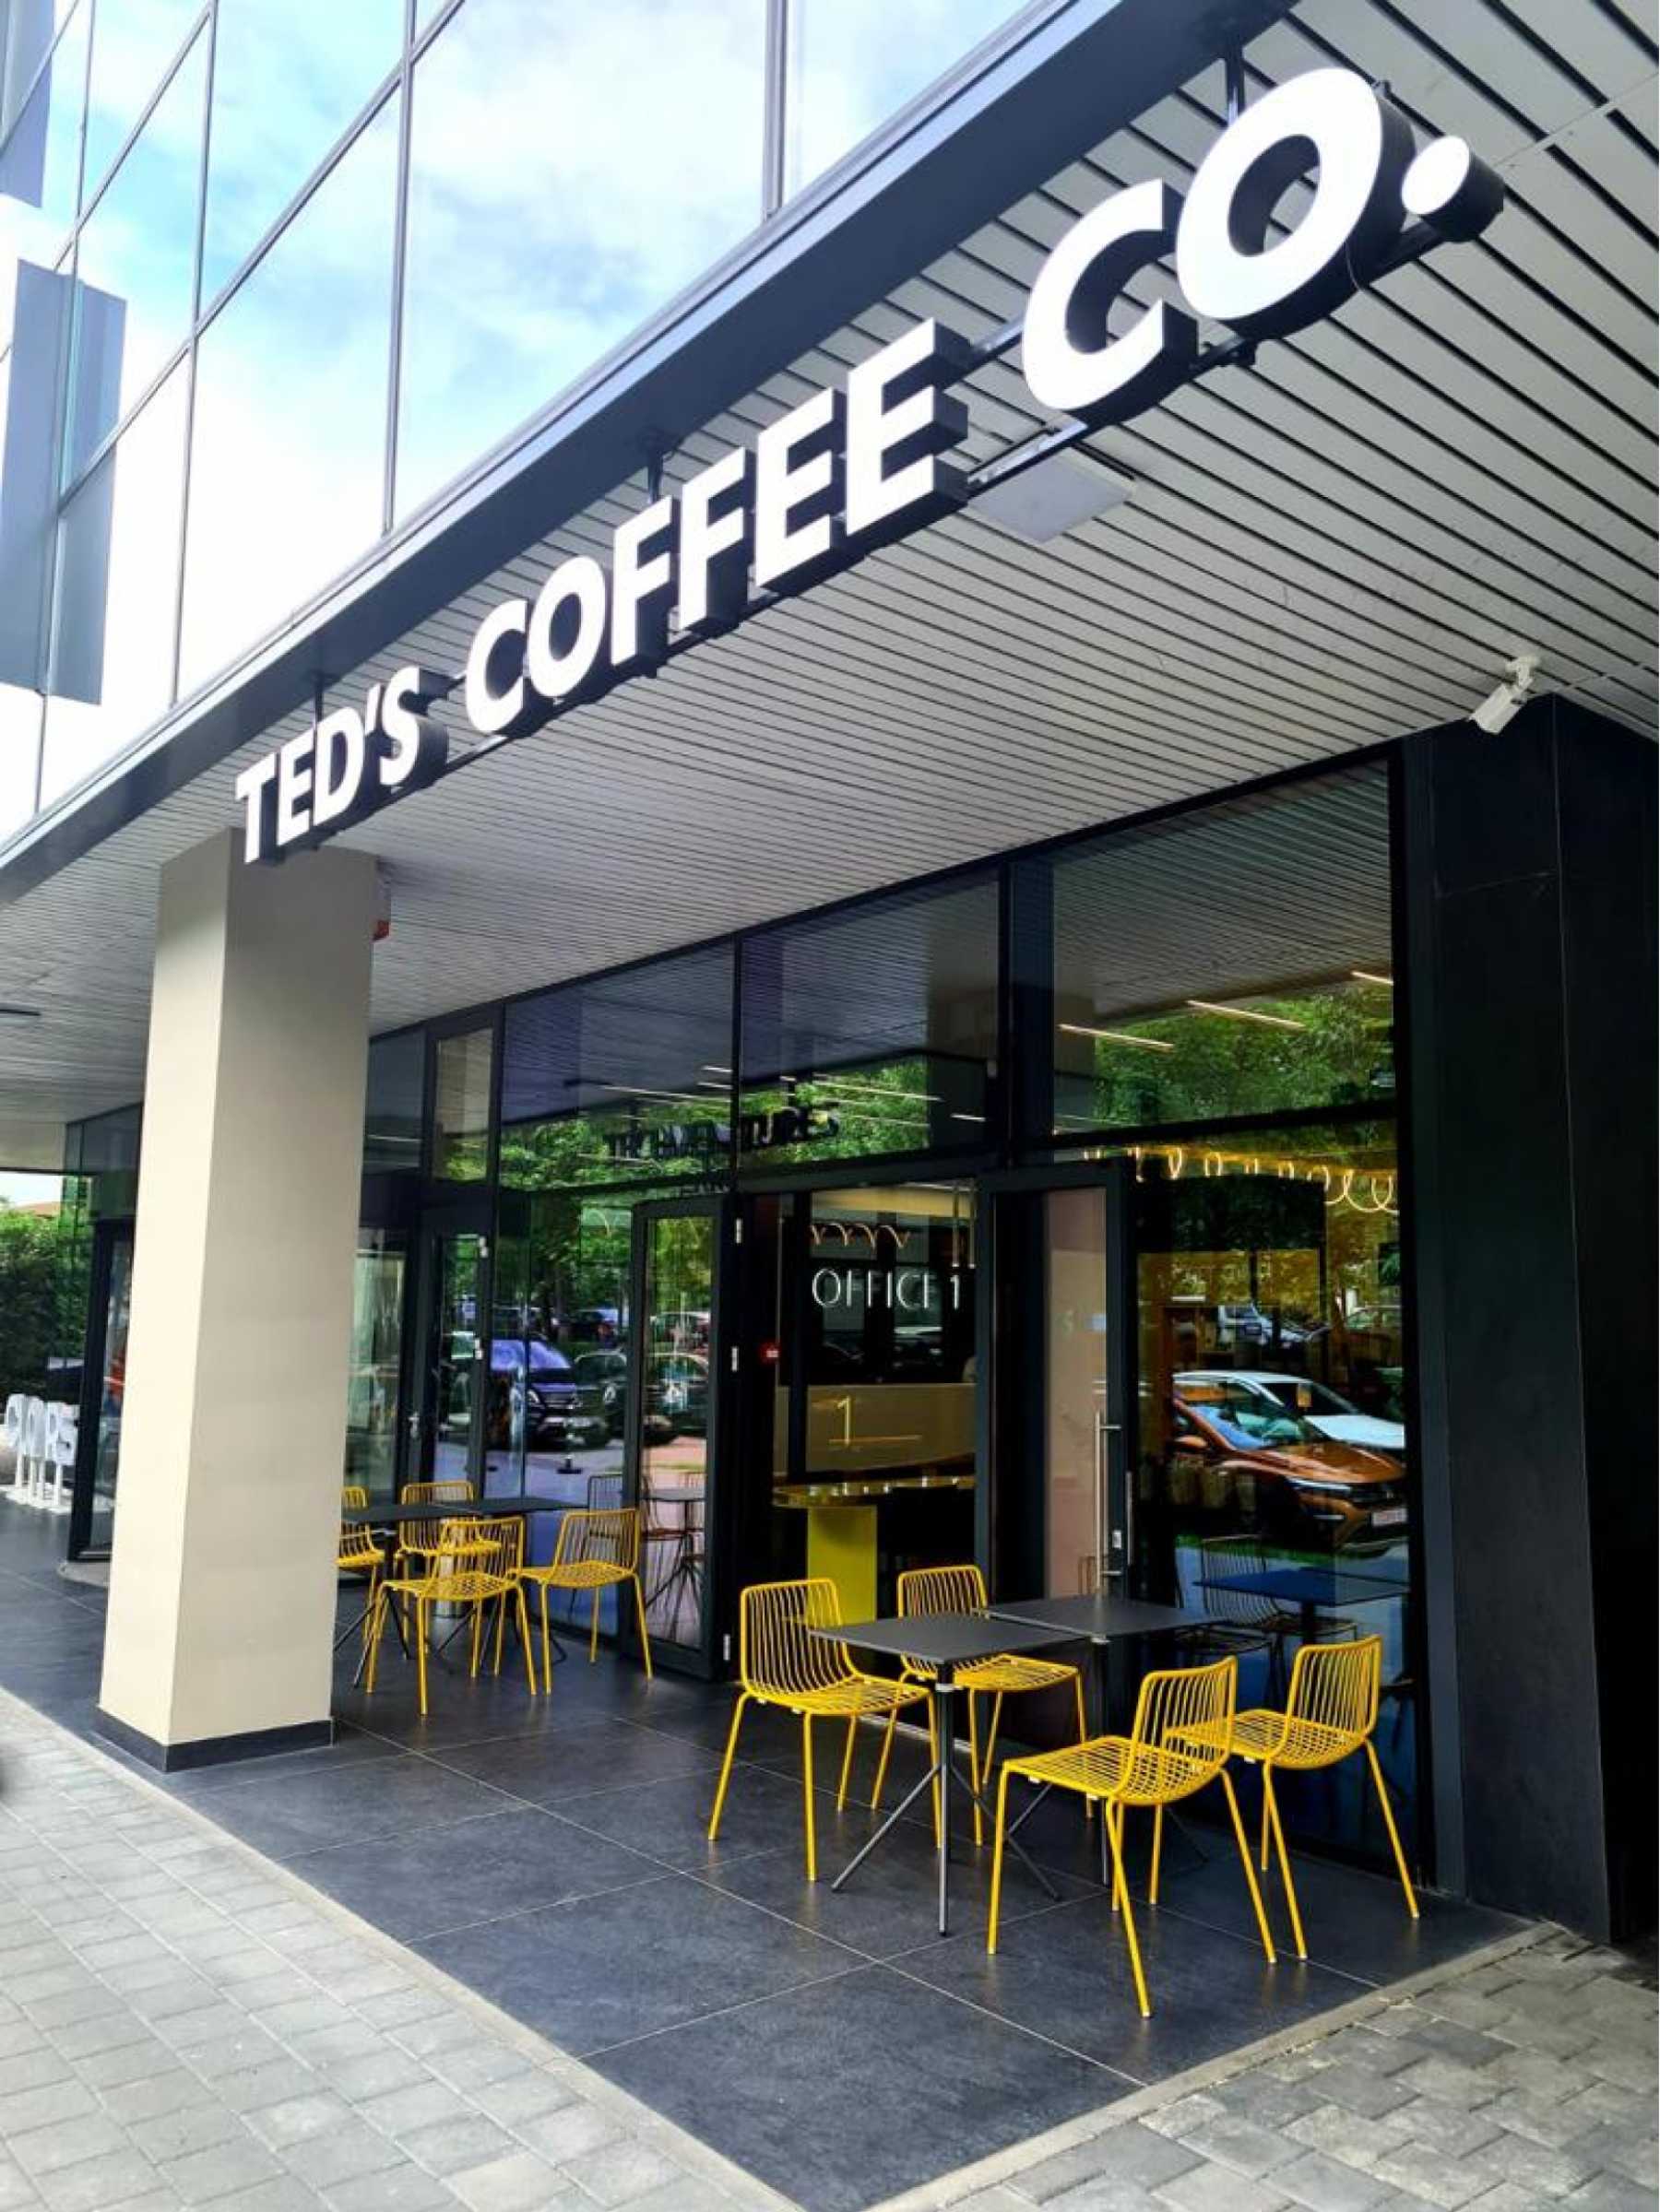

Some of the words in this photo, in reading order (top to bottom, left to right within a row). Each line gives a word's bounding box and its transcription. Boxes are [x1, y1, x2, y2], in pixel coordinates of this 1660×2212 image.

[235, 666, 421, 864] TED'S
[465, 316, 935, 733] COFFEE
[1021, 67, 1471, 410] CO.
[812, 1268, 939, 1310] OFFICE
[949, 1274, 961, 1310] 1
